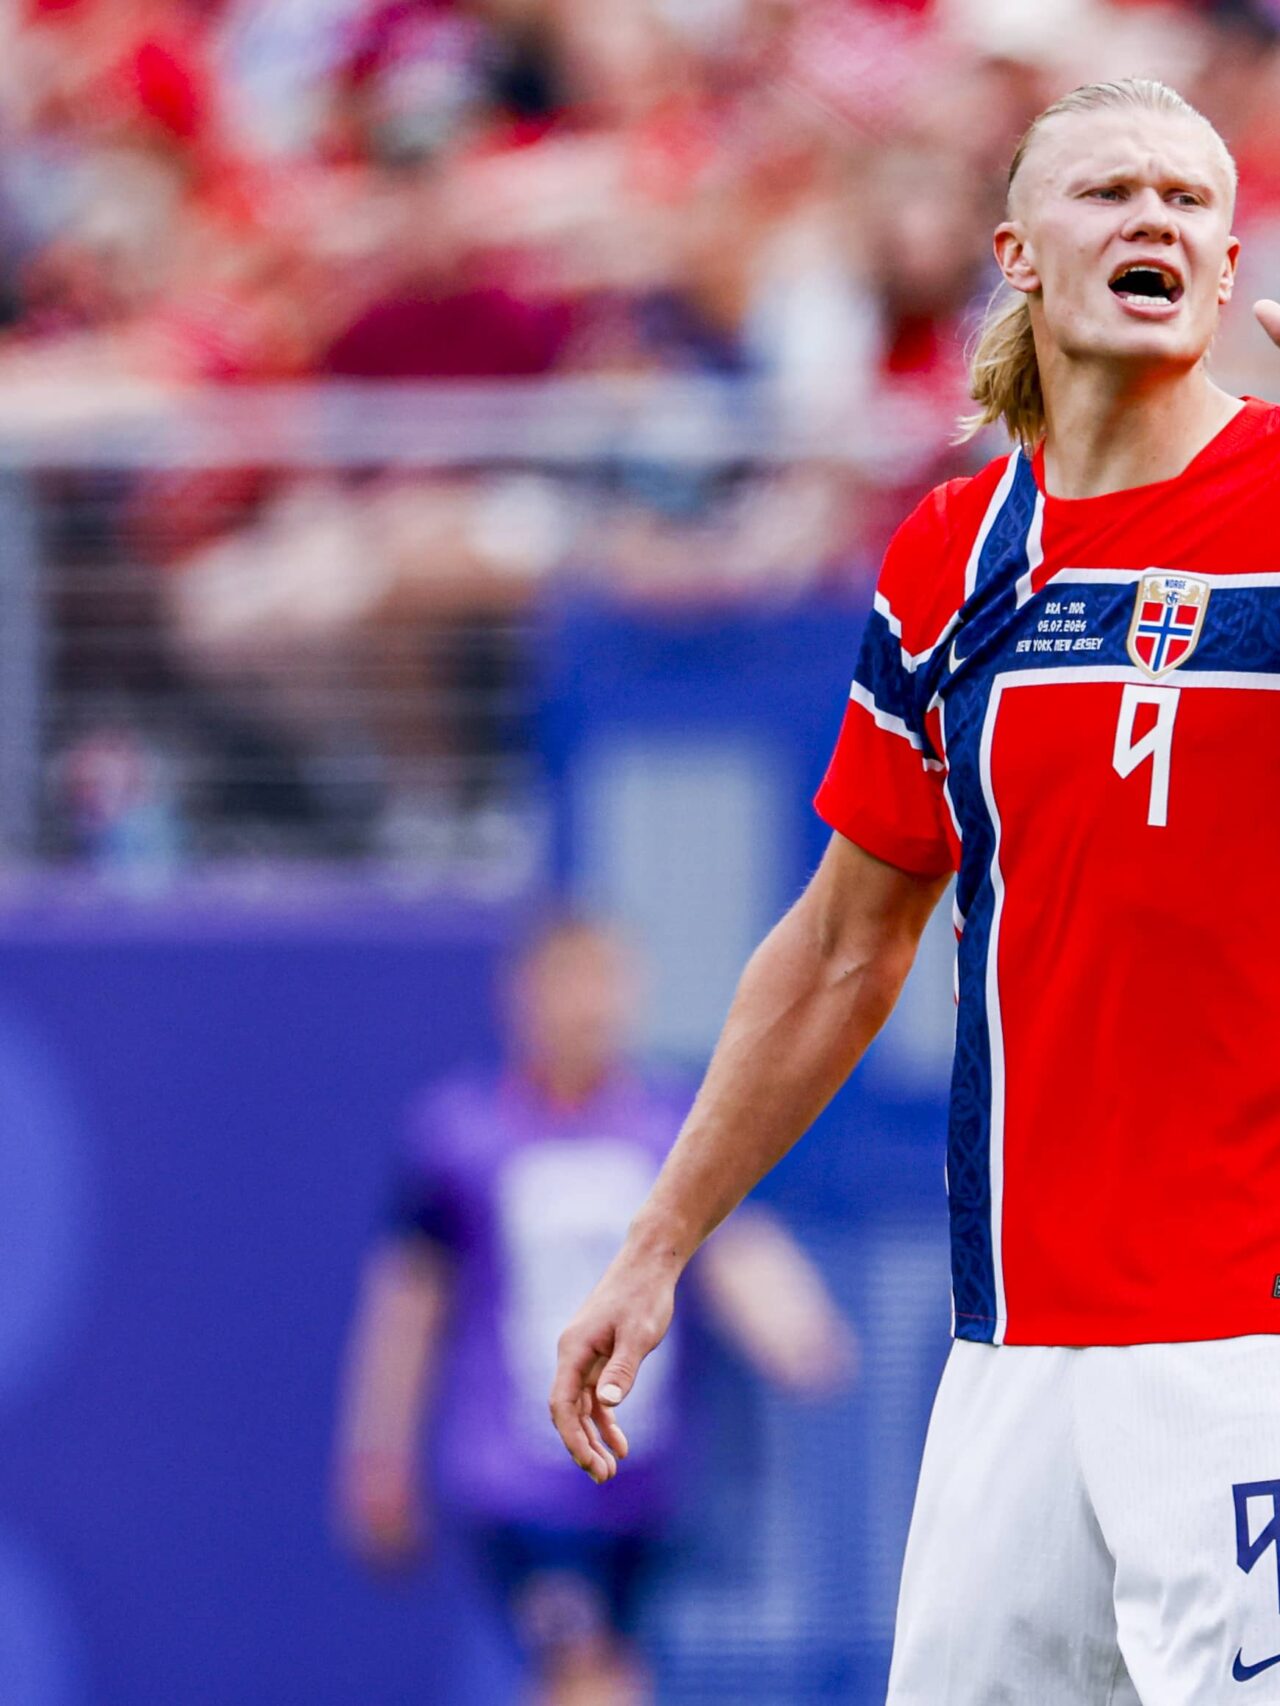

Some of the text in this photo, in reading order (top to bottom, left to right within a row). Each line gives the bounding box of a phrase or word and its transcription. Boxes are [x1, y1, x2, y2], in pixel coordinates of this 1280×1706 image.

[1165, 579, 1186, 590] NORGE
[1068, 602, 1086, 614] NOR
[1037, 620, 1087, 632] 05.07.2026
[1015, 637, 1104, 652] NEW YORK NEW JERSEY
[1112, 683, 1182, 828] 9
